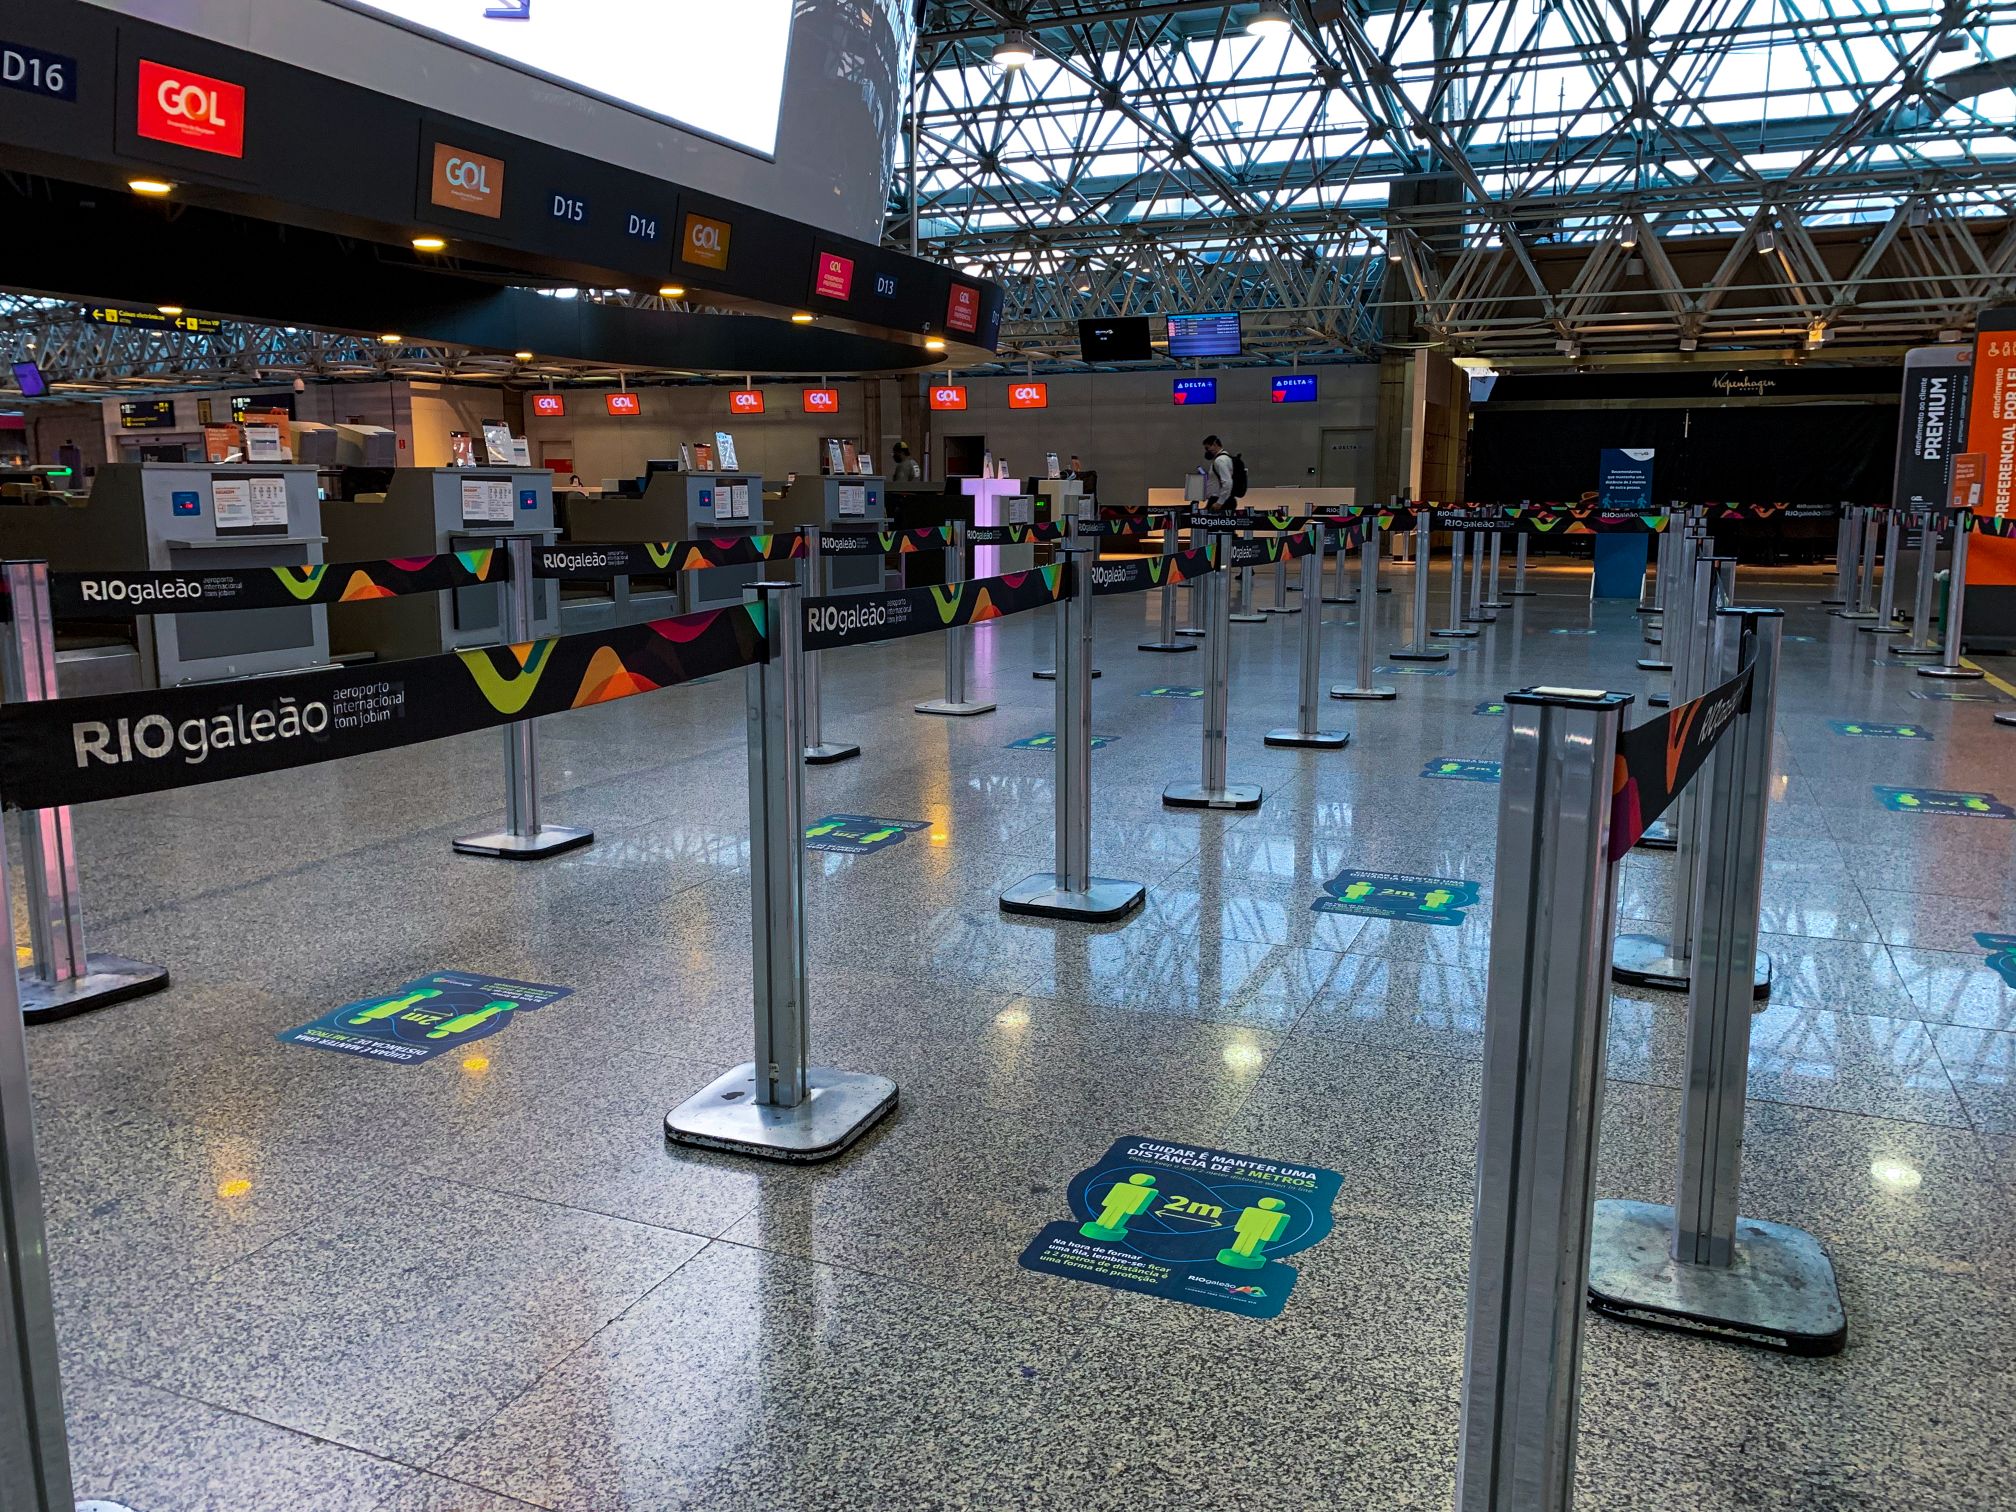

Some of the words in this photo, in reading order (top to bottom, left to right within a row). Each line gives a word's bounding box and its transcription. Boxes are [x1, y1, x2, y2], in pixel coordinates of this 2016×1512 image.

[2, 50, 64, 91] D16
[157, 79, 226, 127] GOL
[445, 158, 491, 193] GOL
[553, 195, 584, 221] D15
[628, 214, 656, 239] D14
[692, 223, 721, 251] GOL
[829, 260, 842, 273] GOL
[877, 277, 894, 295] D13
[959, 291, 970, 304] GOL
[1015, 387, 1040, 400] GOL
[1712, 372, 1776, 396] Kopenhagen
[1919, 377, 1928, 401] cliente
[1992, 367, 2004, 419] atendimento
[538, 398, 559, 409] GOL
[611, 396, 634, 408] GOL
[735, 394, 758, 406] GOL
[809, 392, 832, 405] GOL
[936, 389, 960, 402] GOL
[1919, 402, 1926, 411] ao
[1923, 377, 1948, 460] PREMIUM
[1915, 412, 1925, 456] atendimento
[1191, 516, 1237, 528] RIOgaleão
[1444, 519, 1495, 529] RIOgaleão
[821, 537, 857, 551] RIOgaleão
[966, 530, 993, 542] RIOgaleão
[543, 552, 607, 571] RIOgaleão
[80, 578, 201, 605] RIOgaleão
[808, 602, 886, 636] RIOgaleão
[333, 681, 389, 700] aeroporto
[333, 690, 405, 715] internacional
[334, 715, 358, 728] tom
[359, 709, 391, 728] jobim
[72, 697, 328, 768] RIOgaleão
[1380, 888, 1416, 897] 2m
[401, 1012, 442, 1025] 2m
[319, 1038, 361, 1052] MANTER
[370, 1048, 413, 1060] CUIDAR
[371, 1041, 429, 1056] DISTÂNCIA
[1127, 1148, 1207, 1168] DISTÂNCIA
[1210, 1163, 1233, 1173] DE
[1234, 1168, 1246, 1176] 2
[1247, 1170, 1319, 1189] METROS.
[1139, 1142, 1196, 1158] CUIDAR
[1198, 1151, 1210, 1160] É
[1211, 1155, 1277, 1173] MANTER
[1280, 1168, 1317, 1181] UMA
[1163, 1195, 1223, 1219] 2m
[1053, 1238, 1067, 1246] Na
[1067, 1241, 1091, 1250] hora
[1092, 1246, 1105, 1254] de
[1107, 1249, 1142, 1260] formar
[1048, 1245, 1070, 1253] uma
[1071, 1248, 1090, 1257] fila,
[1092, 1252, 1147, 1268] lembre-se:
[1148, 1264, 1171, 1273] ficar
[1060, 1253, 1096, 1264] metros
[1112, 1263, 1160, 1277] distância
[1039, 1255, 1061, 1264] uma
[1063, 1259, 1093, 1270] forma
[1109, 1270, 1158, 1284] proteção.
[1187, 1275, 1237, 1289] RIOgaleão
